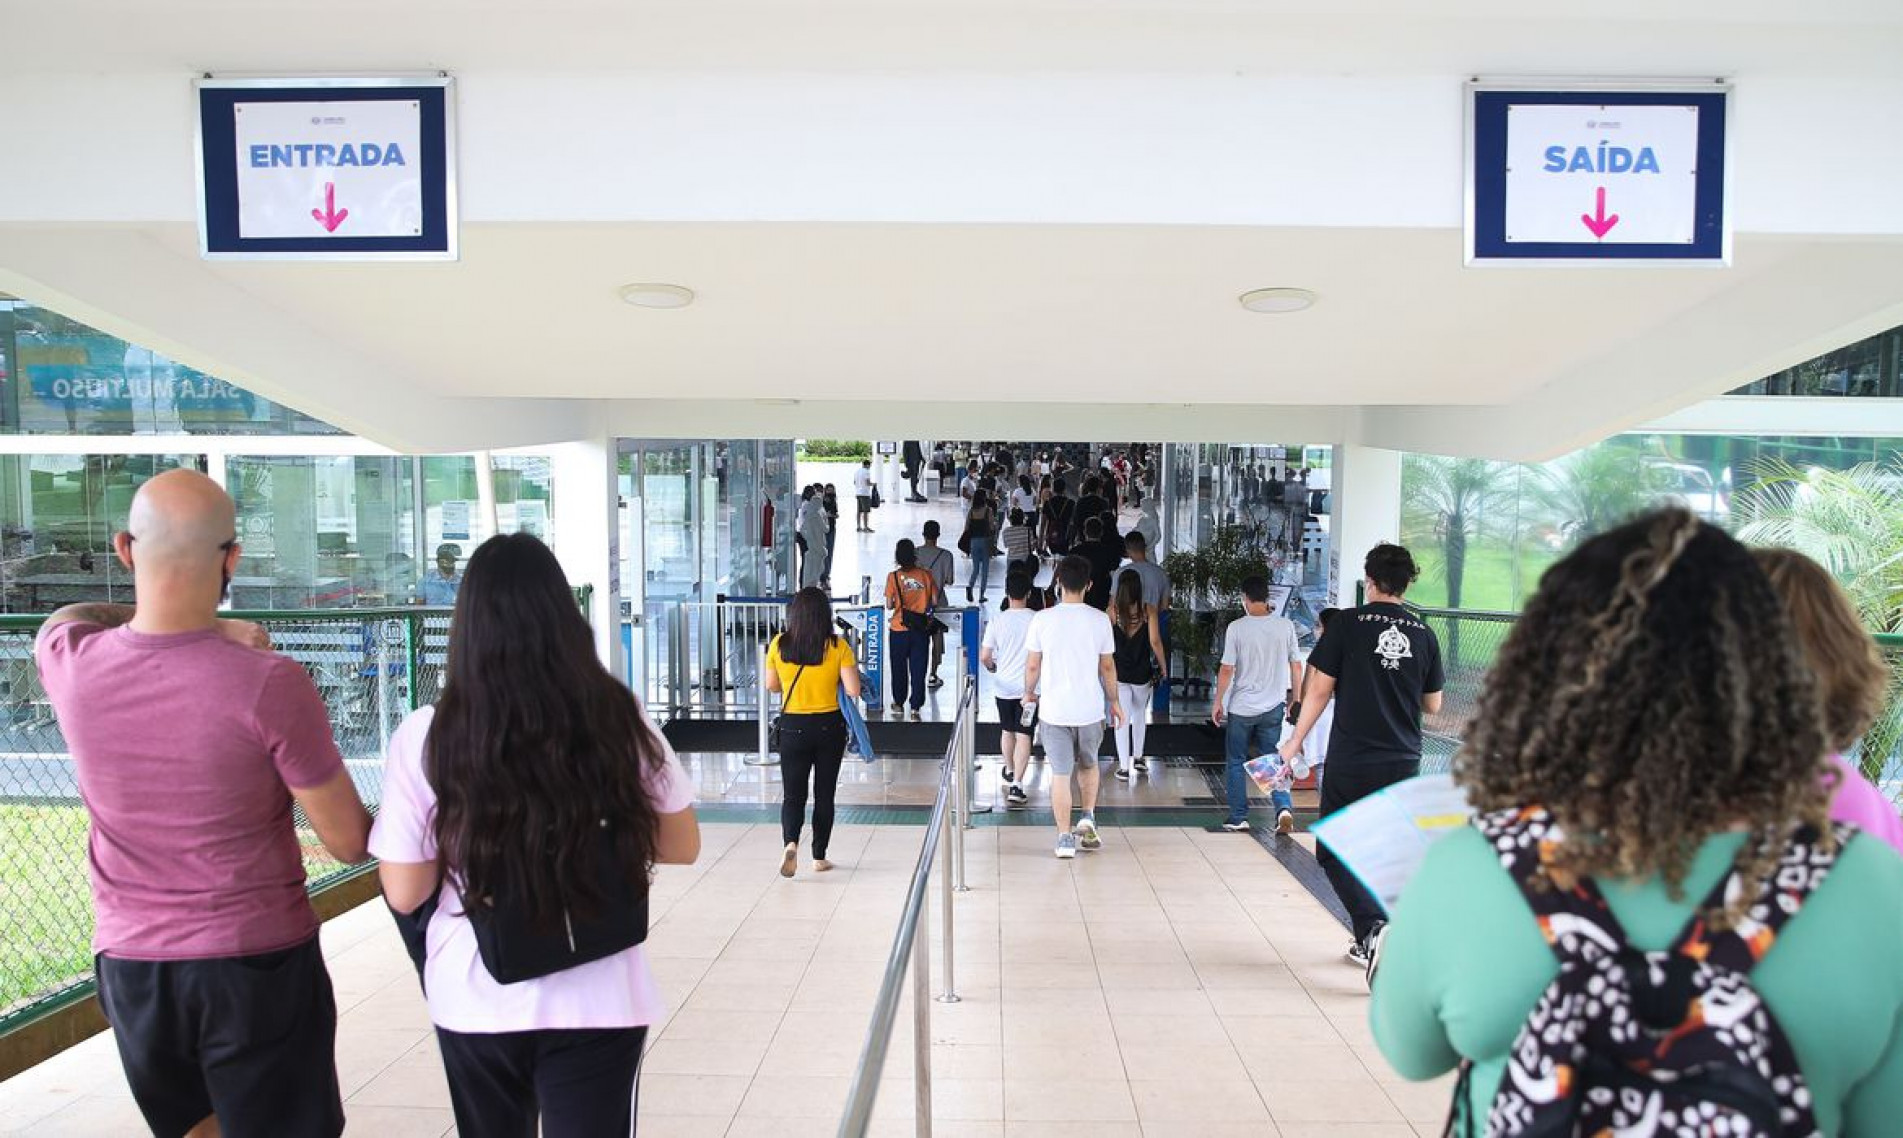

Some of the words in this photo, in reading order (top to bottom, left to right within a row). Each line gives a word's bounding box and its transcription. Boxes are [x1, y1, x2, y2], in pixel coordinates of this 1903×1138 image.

[250, 142, 406, 168] ENTRADA
[1543, 140, 1660, 173] SAÍDA
[868, 615, 878, 671] ENTRADA
